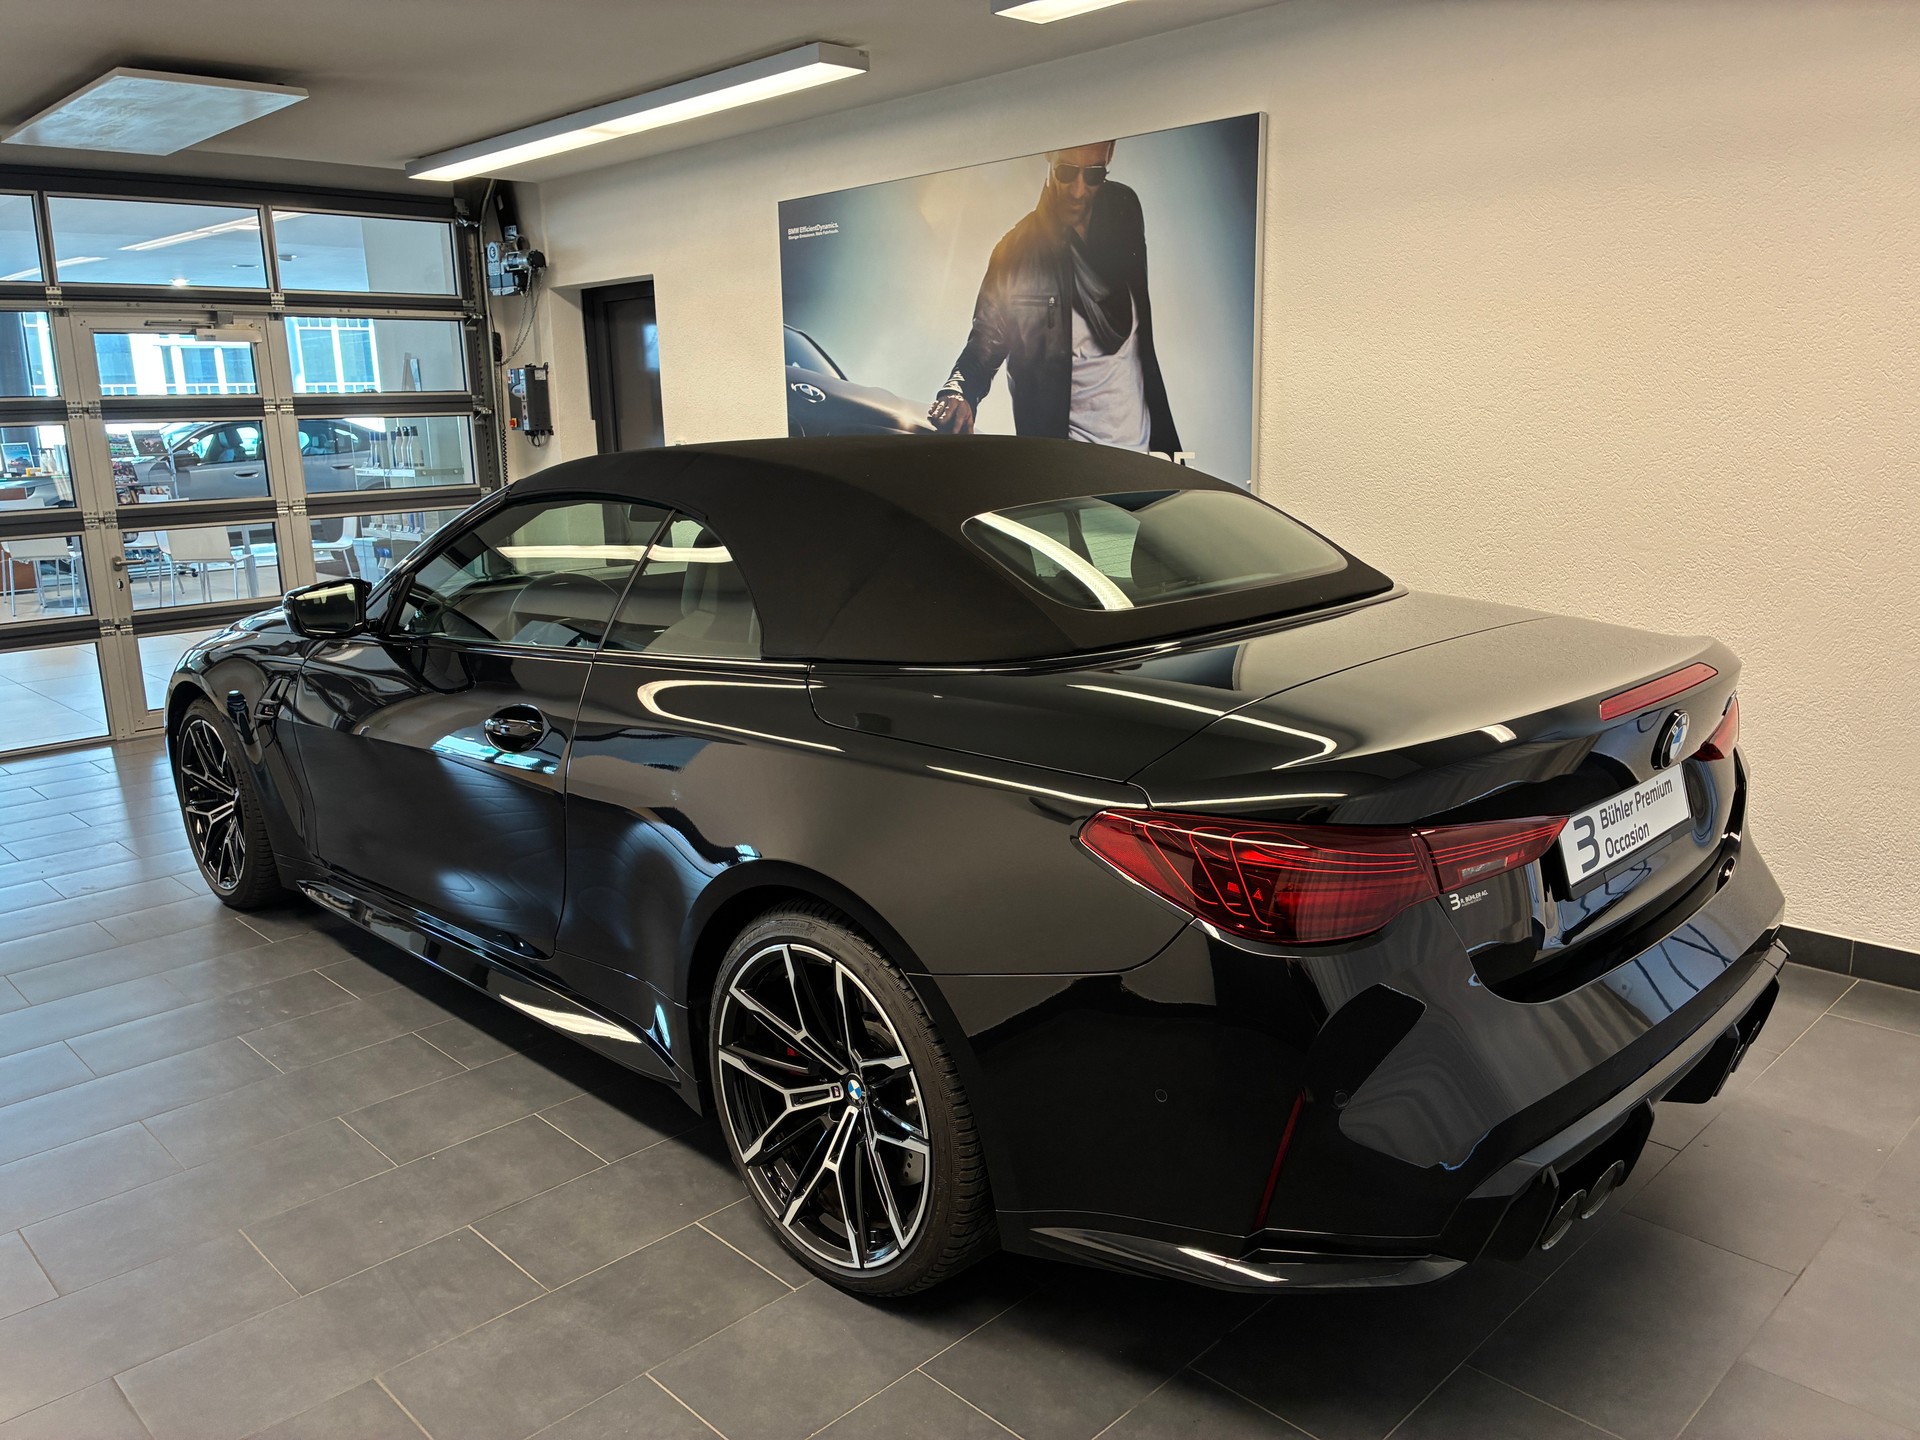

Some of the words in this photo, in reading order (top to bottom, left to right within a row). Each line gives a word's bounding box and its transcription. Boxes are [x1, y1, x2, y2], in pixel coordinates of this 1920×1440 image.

[1599, 799, 1634, 830] Bühler
[1634, 778, 1673, 812] Premium
[1605, 822, 1650, 859] Occasion
